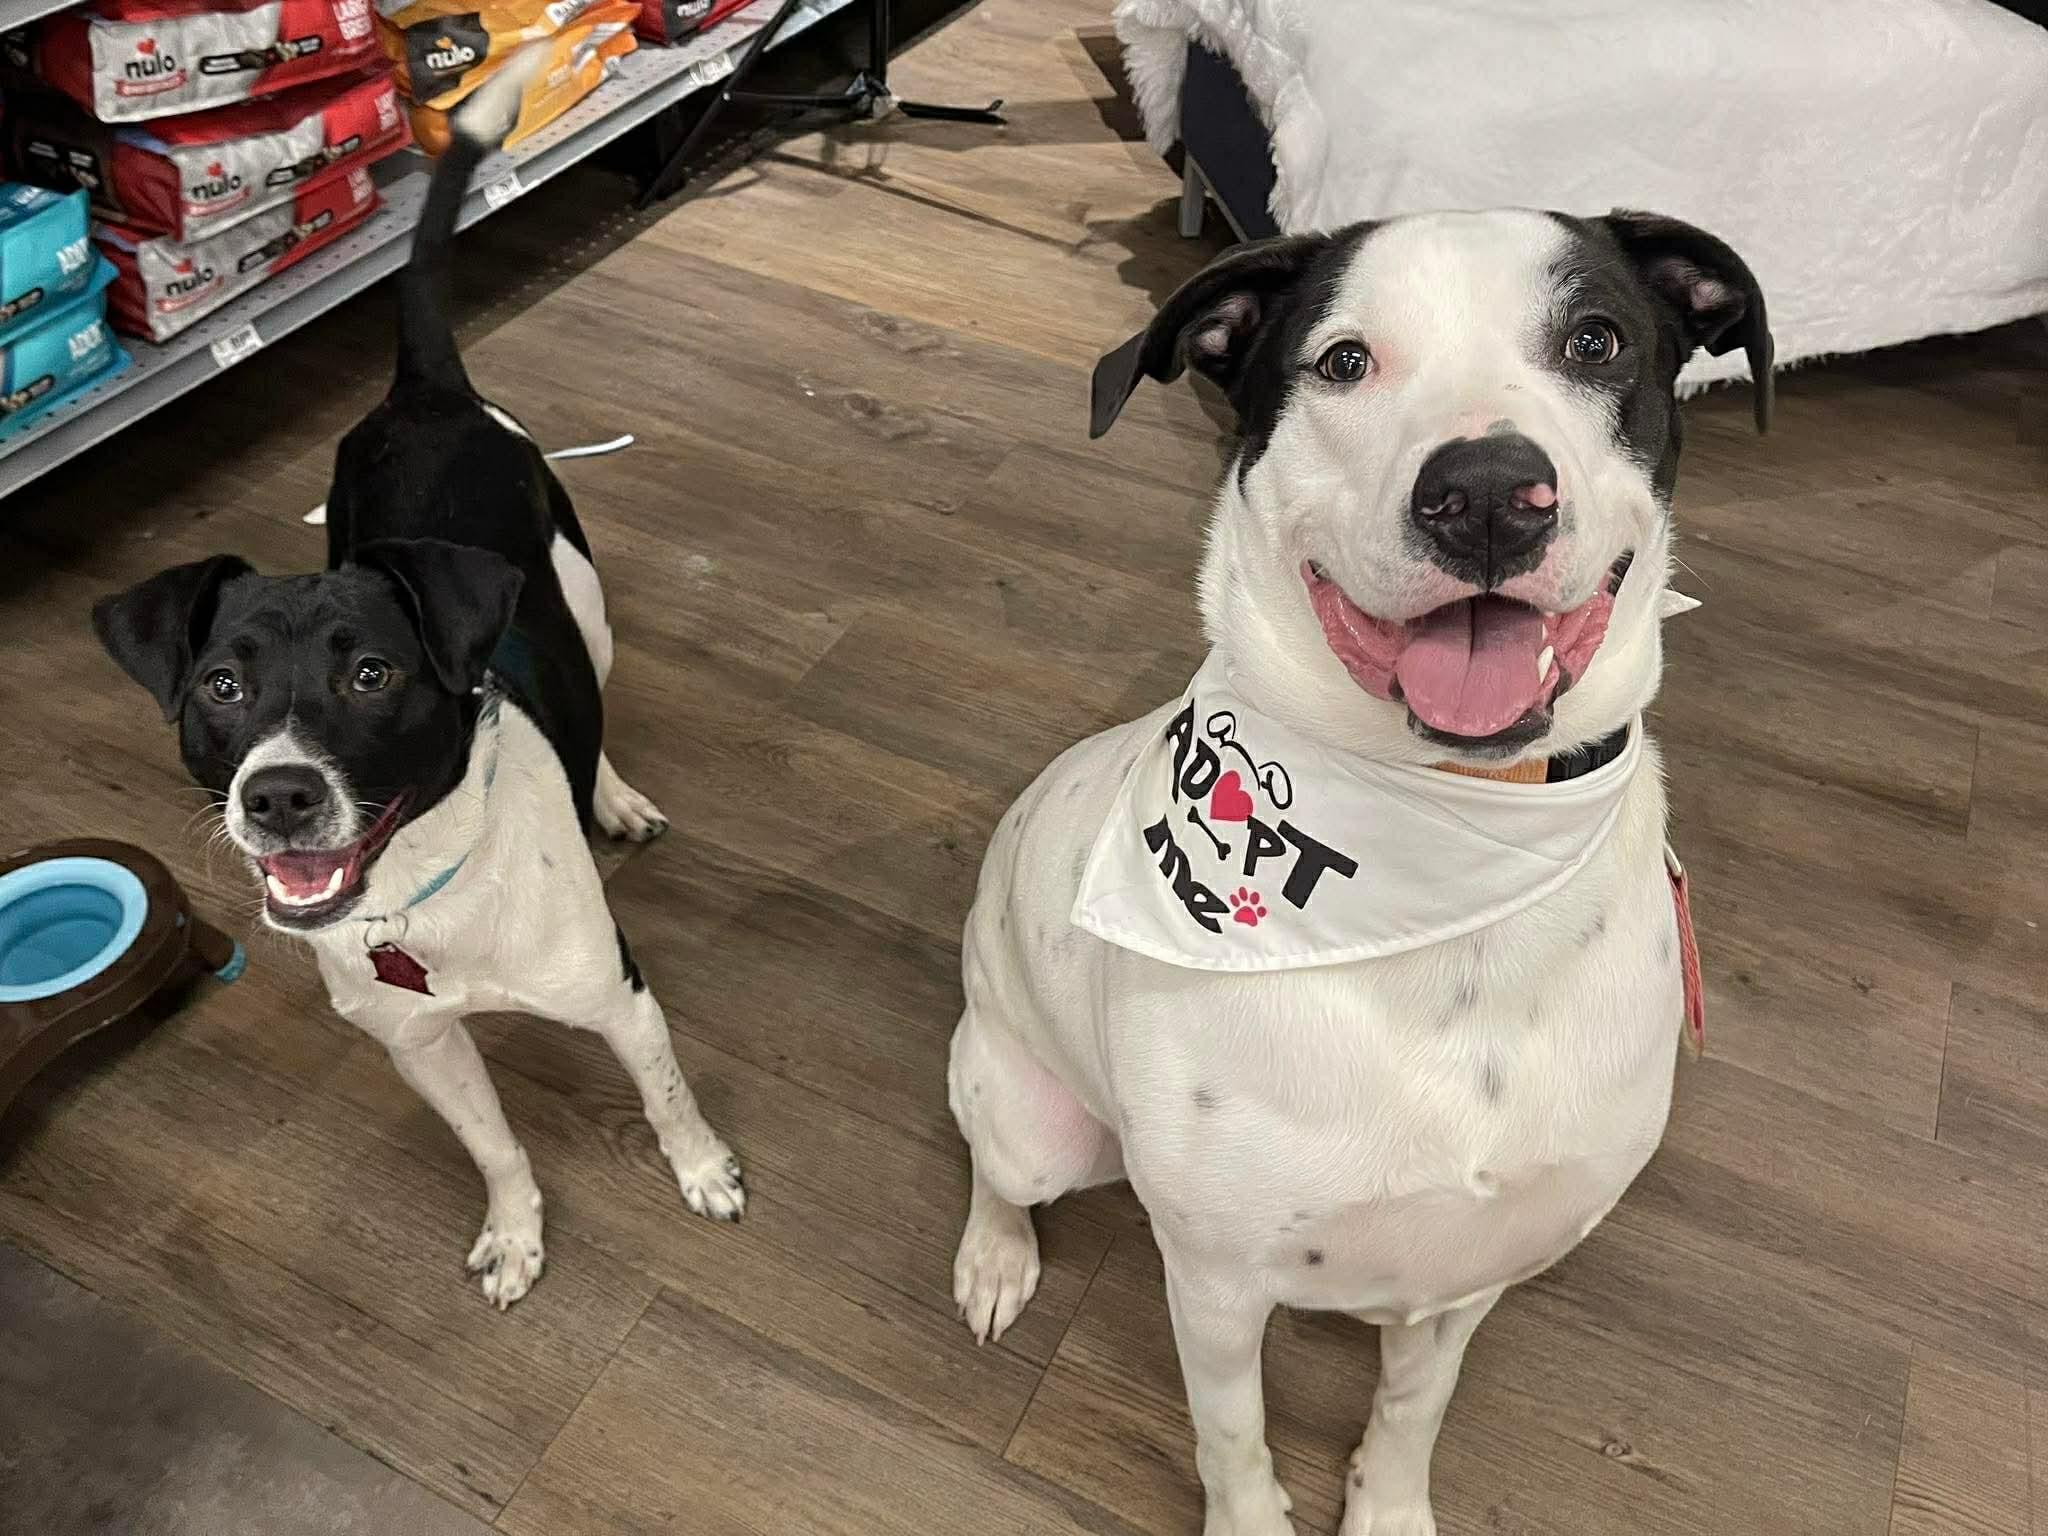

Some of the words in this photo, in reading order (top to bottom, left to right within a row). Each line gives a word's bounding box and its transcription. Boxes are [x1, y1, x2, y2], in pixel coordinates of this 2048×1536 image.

[125, 49, 175, 78] nulo
[426, 43, 476, 69] nulo
[192, 171, 241, 199] nulo
[166, 267, 213, 295] nulo
[1166, 698, 1359, 910] ADPT
[1143, 813, 1231, 934] me
